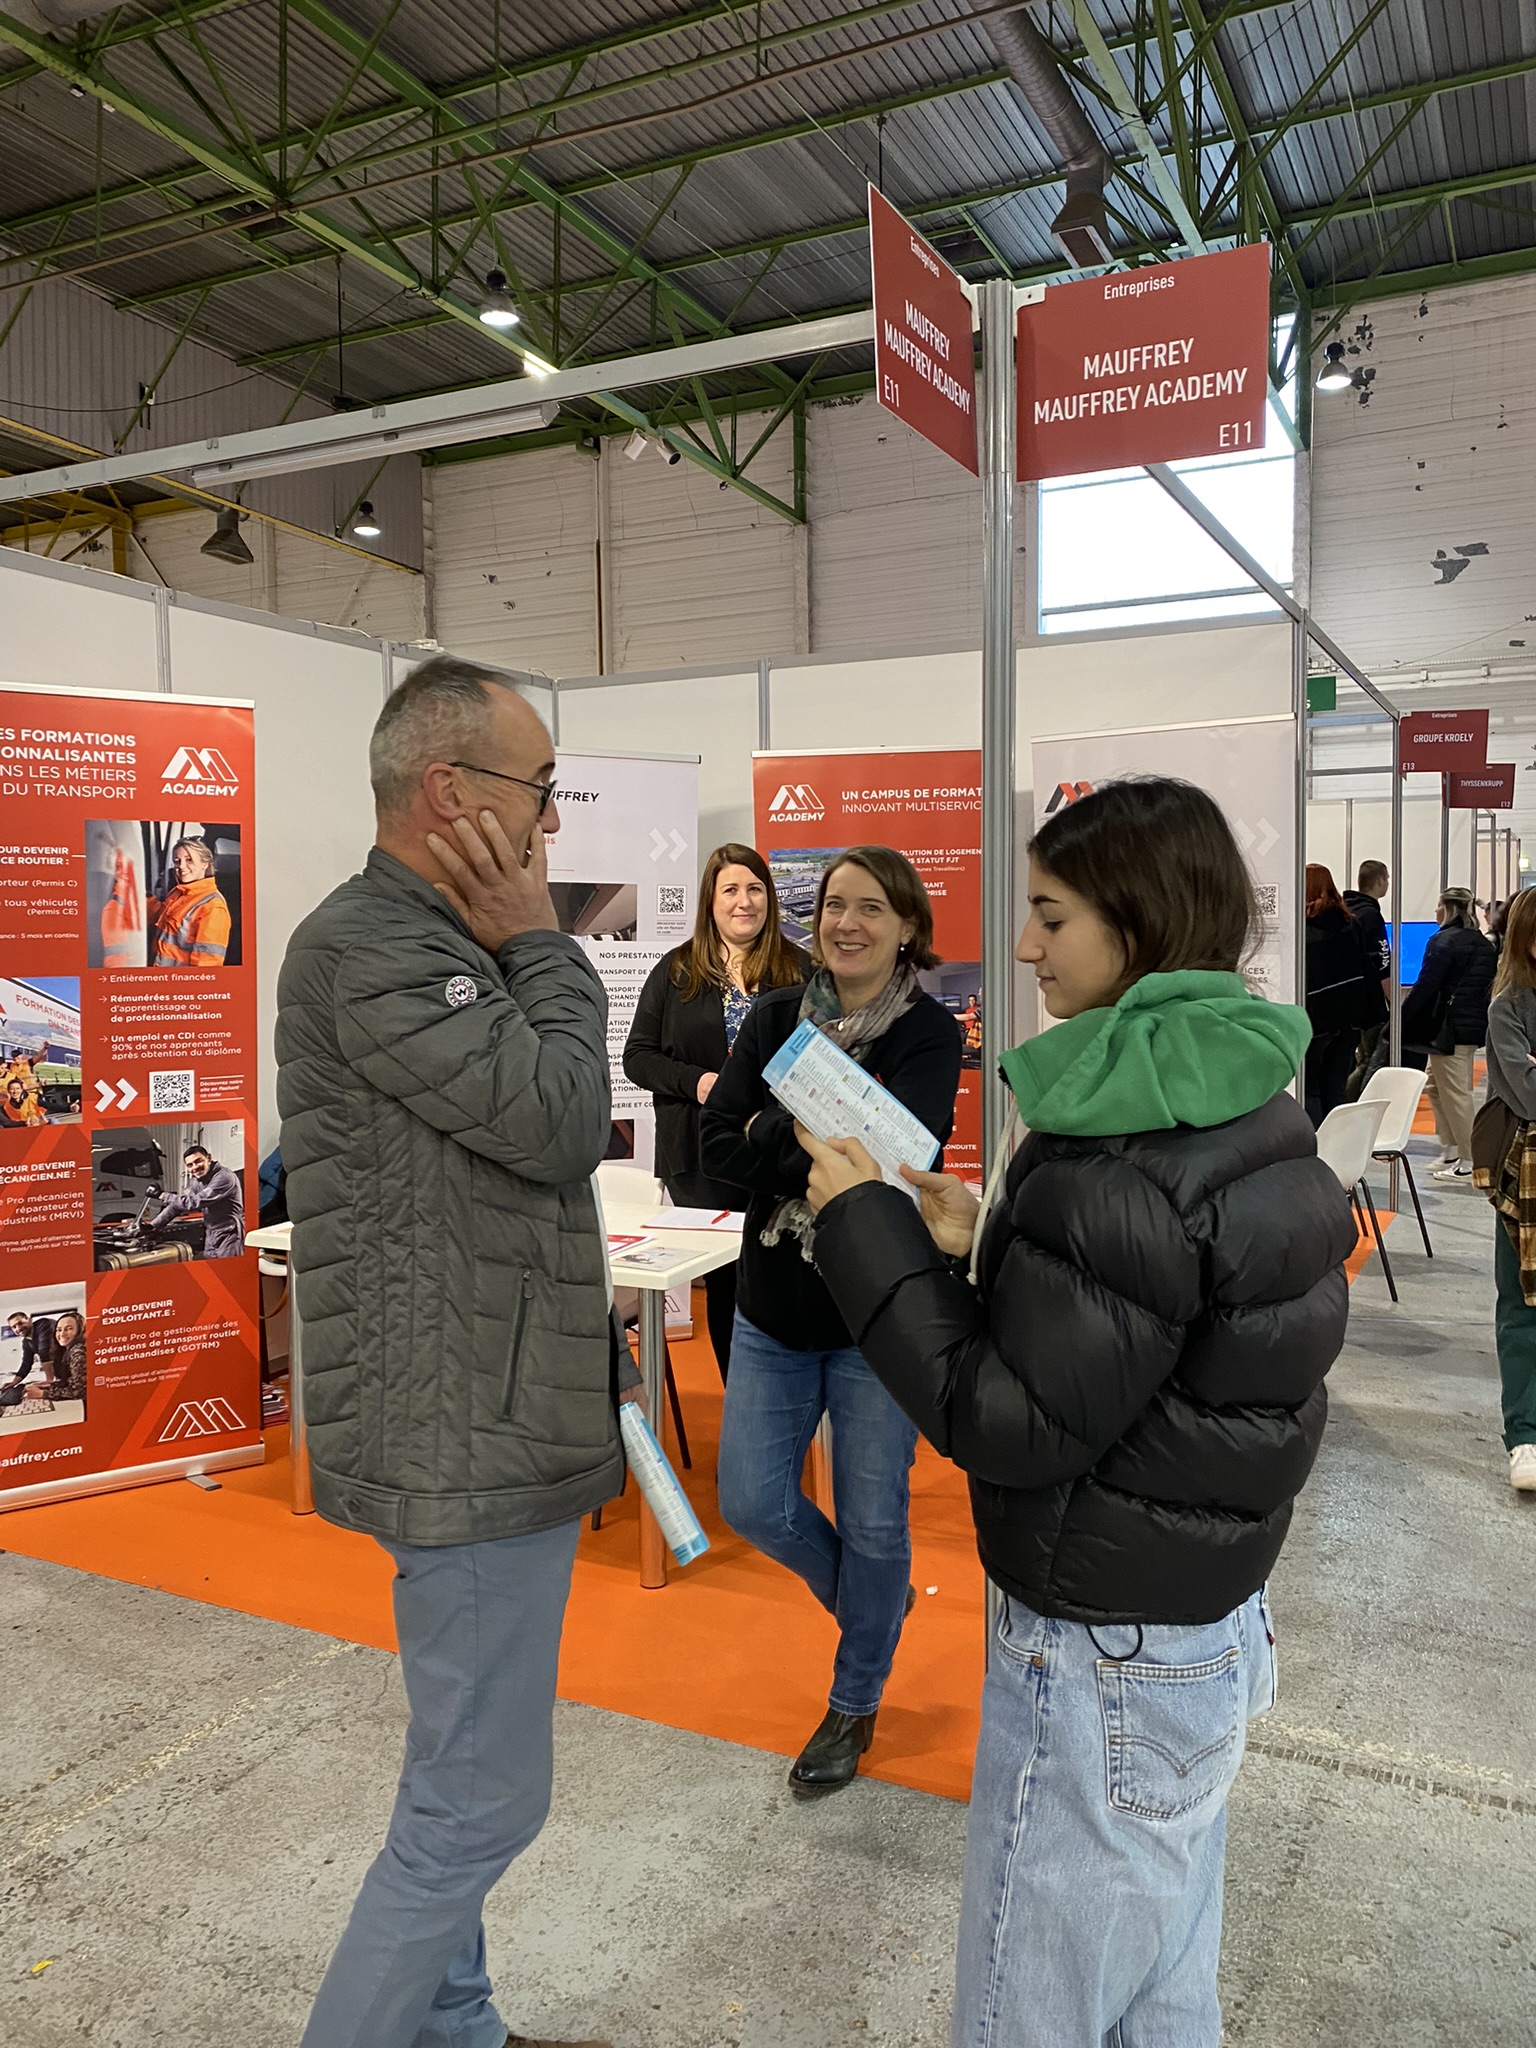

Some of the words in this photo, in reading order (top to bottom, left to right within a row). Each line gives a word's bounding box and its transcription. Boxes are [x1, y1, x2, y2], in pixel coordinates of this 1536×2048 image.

[910, 235, 940, 278] Entreprises
[1103, 274, 1175, 300] Entreprises
[905, 299, 950, 361] MAUFFREY
[1083, 337, 1195, 380] MAUFFREY
[884, 318, 932, 382] MAUFFREY
[932, 363, 971, 415] ACADEMY
[884, 374, 900, 408] E11
[1034, 384, 1141, 425] MAUFFREY
[1144, 367, 1248, 408] ACADEMY
[1219, 420, 1253, 447] E11
[20, 729, 137, 748] FORMATIONS
[1413, 734, 1443, 743] GROUPE
[1444, 733, 1474, 742] KROELY
[0, 746, 137, 765] ONNALISANTES
[29, 765, 60, 779] LES
[65, 765, 137, 782] MÉTIERS
[1402, 762, 1415, 771] E13
[3, 782, 28, 796] DU
[33, 783, 137, 800] TRANSPORT
[161, 782, 240, 797] ACADEMY
[841, 791, 859, 801] UN
[861, 789, 911, 800] CAMPUS
[913, 788, 930, 798] DE
[933, 787, 982, 798] FORMAT
[842, 802, 902, 814] INNOVANT
[905, 800, 982, 812] MULTISERVIC
[768, 812, 825, 823] ACADEMY
[22, 846, 69, 855] DEVENIR
[18, 856, 64, 865] ROUTIER
[32, 879, 65, 888] (Permis
[67, 880, 78, 888] C)
[4, 899, 28, 907] tous
[30, 898, 79, 907] véhicules
[27, 908, 60, 916] (Permis
[62, 908, 79, 916] CE)
[109, 973, 169, 983] Entièrement
[171, 973, 216, 981] financées
[110, 993, 170, 1003] Rémunérées
[173, 993, 195, 1001] sous
[196, 992, 231, 1001] contrat
[15, 994, 67, 1021] FORMATION
[110, 1014, 123, 1023] de
[125, 1012, 222, 1023] professionnalisation
[111, 1034, 125, 1043] Un
[127, 1033, 160, 1043] emploi
[177, 1032, 195, 1040] CDI
[197, 1031, 232, 1039] comme
[111, 1043, 133, 1052] 90%
[135, 1042, 148, 1050] de
[169, 1040, 223, 1050] apprenants
[111, 1052, 138, 1061] après
[140, 1050, 188, 1059] obtention
[190, 1049, 203, 1057] du
[205, 1047, 242, 1056] diplôme
[0, 1164, 28, 1174] POUR
[31, 1160, 76, 1171] DEVENIR
[6, 1197, 25, 1205] Pro
[27, 1191, 84, 1203] mécanicien
[15, 1202, 69, 1214] réparateur
[71, 1200, 85, 1209] de
[49, 1210, 85, 1222] (MRVI)
[102, 1305, 129, 1315] POUR
[131, 1299, 173, 1312] DEVENIR
[102, 1309, 170, 1325] EXPLOITANT.E
[105, 1334, 128, 1345] Titre
[130, 1332, 147, 1341] Pro
[149, 1330, 161, 1338] de
[163, 1323, 220, 1337] gestionnaire
[222, 1320, 239, 1329] des
[94, 1342, 147, 1356] opérations
[163, 1333, 207, 1345] transport
[209, 1329, 241, 1339] routier
[94, 1357, 107, 1365] de
[110, 1348, 175, 1363] marchandises
[177, 1341, 220, 1354] (GOTRM)
[0, 1445, 83, 1467] auffrey.com
